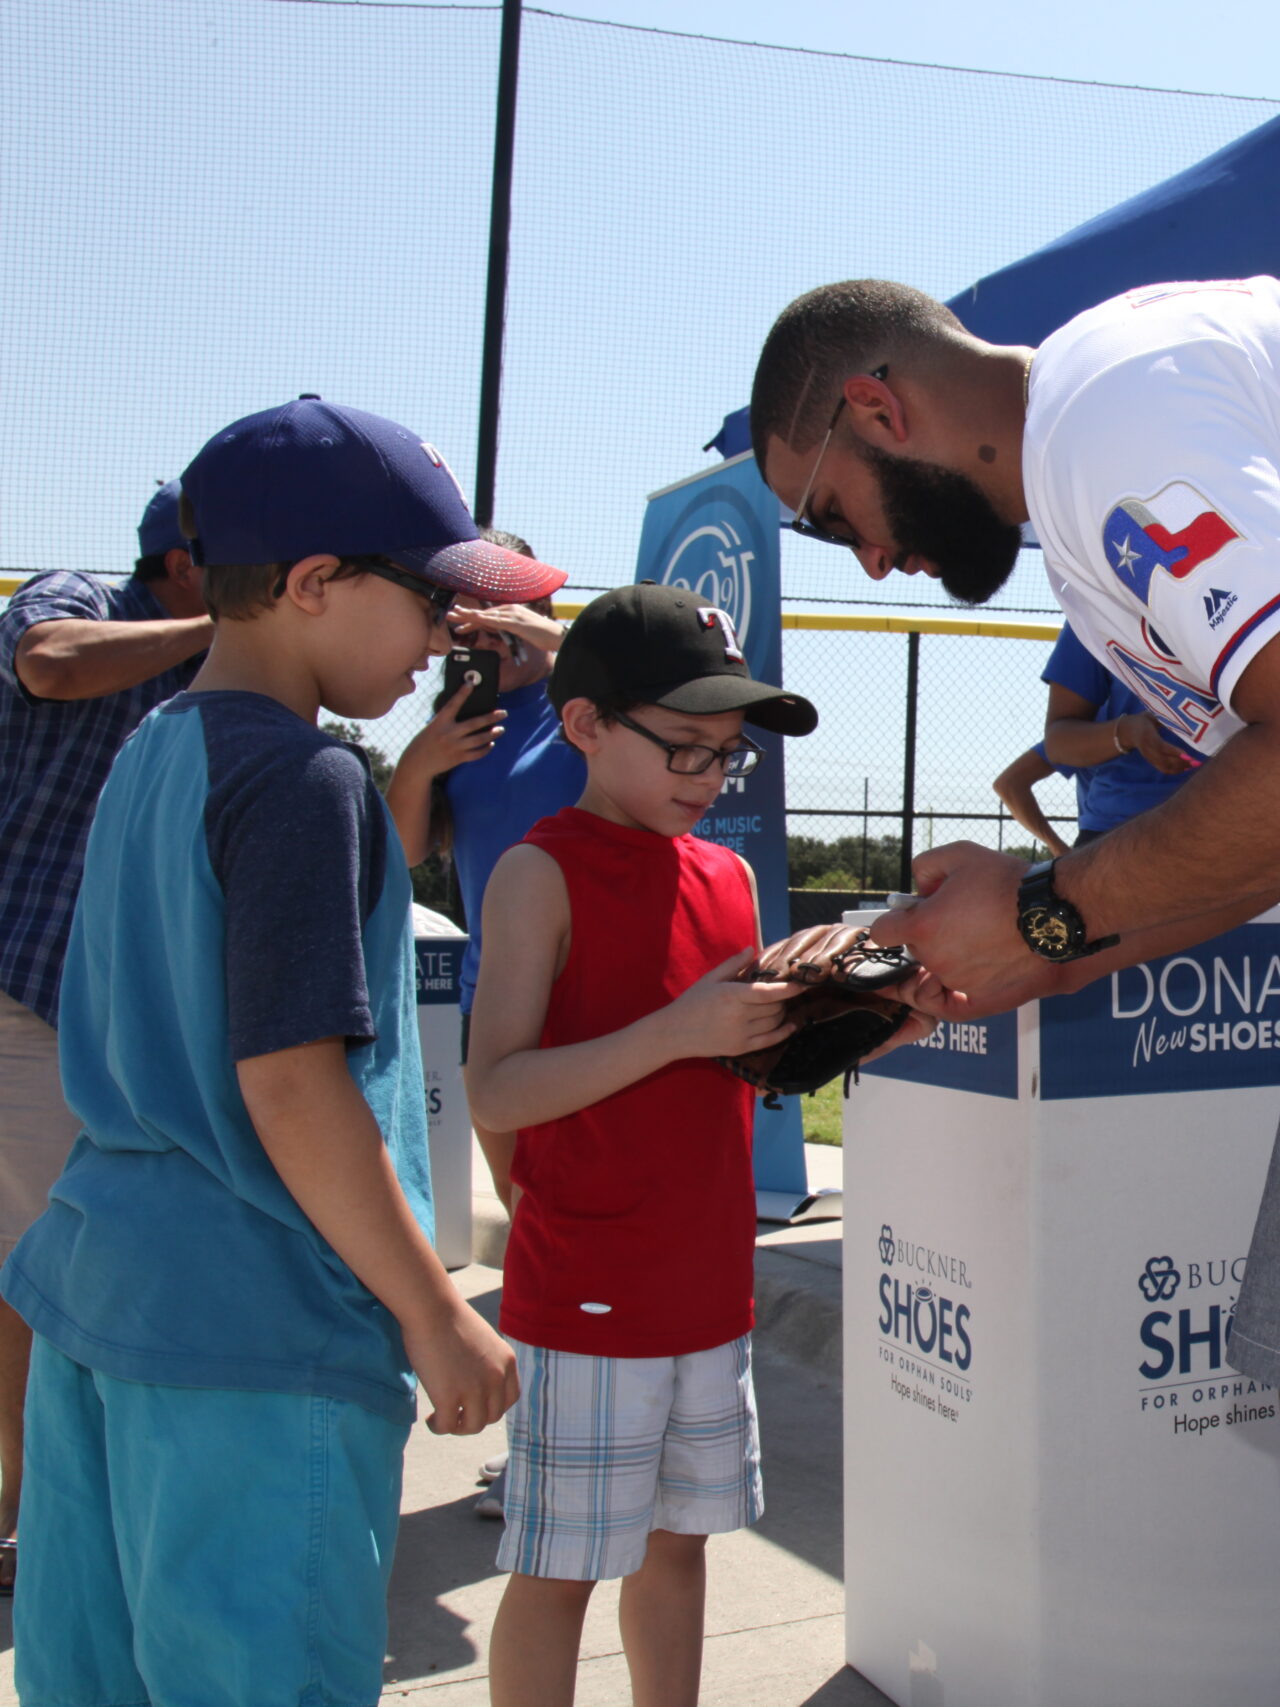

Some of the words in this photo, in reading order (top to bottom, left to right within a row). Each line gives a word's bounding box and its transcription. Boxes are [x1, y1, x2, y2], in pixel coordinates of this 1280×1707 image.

[1208, 594, 1238, 631] Majestic
[696, 607, 745, 665] T
[715, 816, 761, 834] MUSIC
[424, 978, 453, 990] HERE
[949, 1022, 987, 1054] HERE
[1133, 1017, 1187, 1067] New
[897, 1239, 971, 1288] BUCKNER
[878, 1273, 972, 1371] SHOES
[879, 1346, 895, 1366] FOR
[899, 1357, 935, 1385] ORPHAN
[891, 1373, 911, 1400] Hope
[912, 1384, 936, 1412] shines
[1141, 1393, 1178, 1411] FOR
[1174, 1414, 1220, 1436] Hope
[1226, 1404, 1276, 1425] shines
